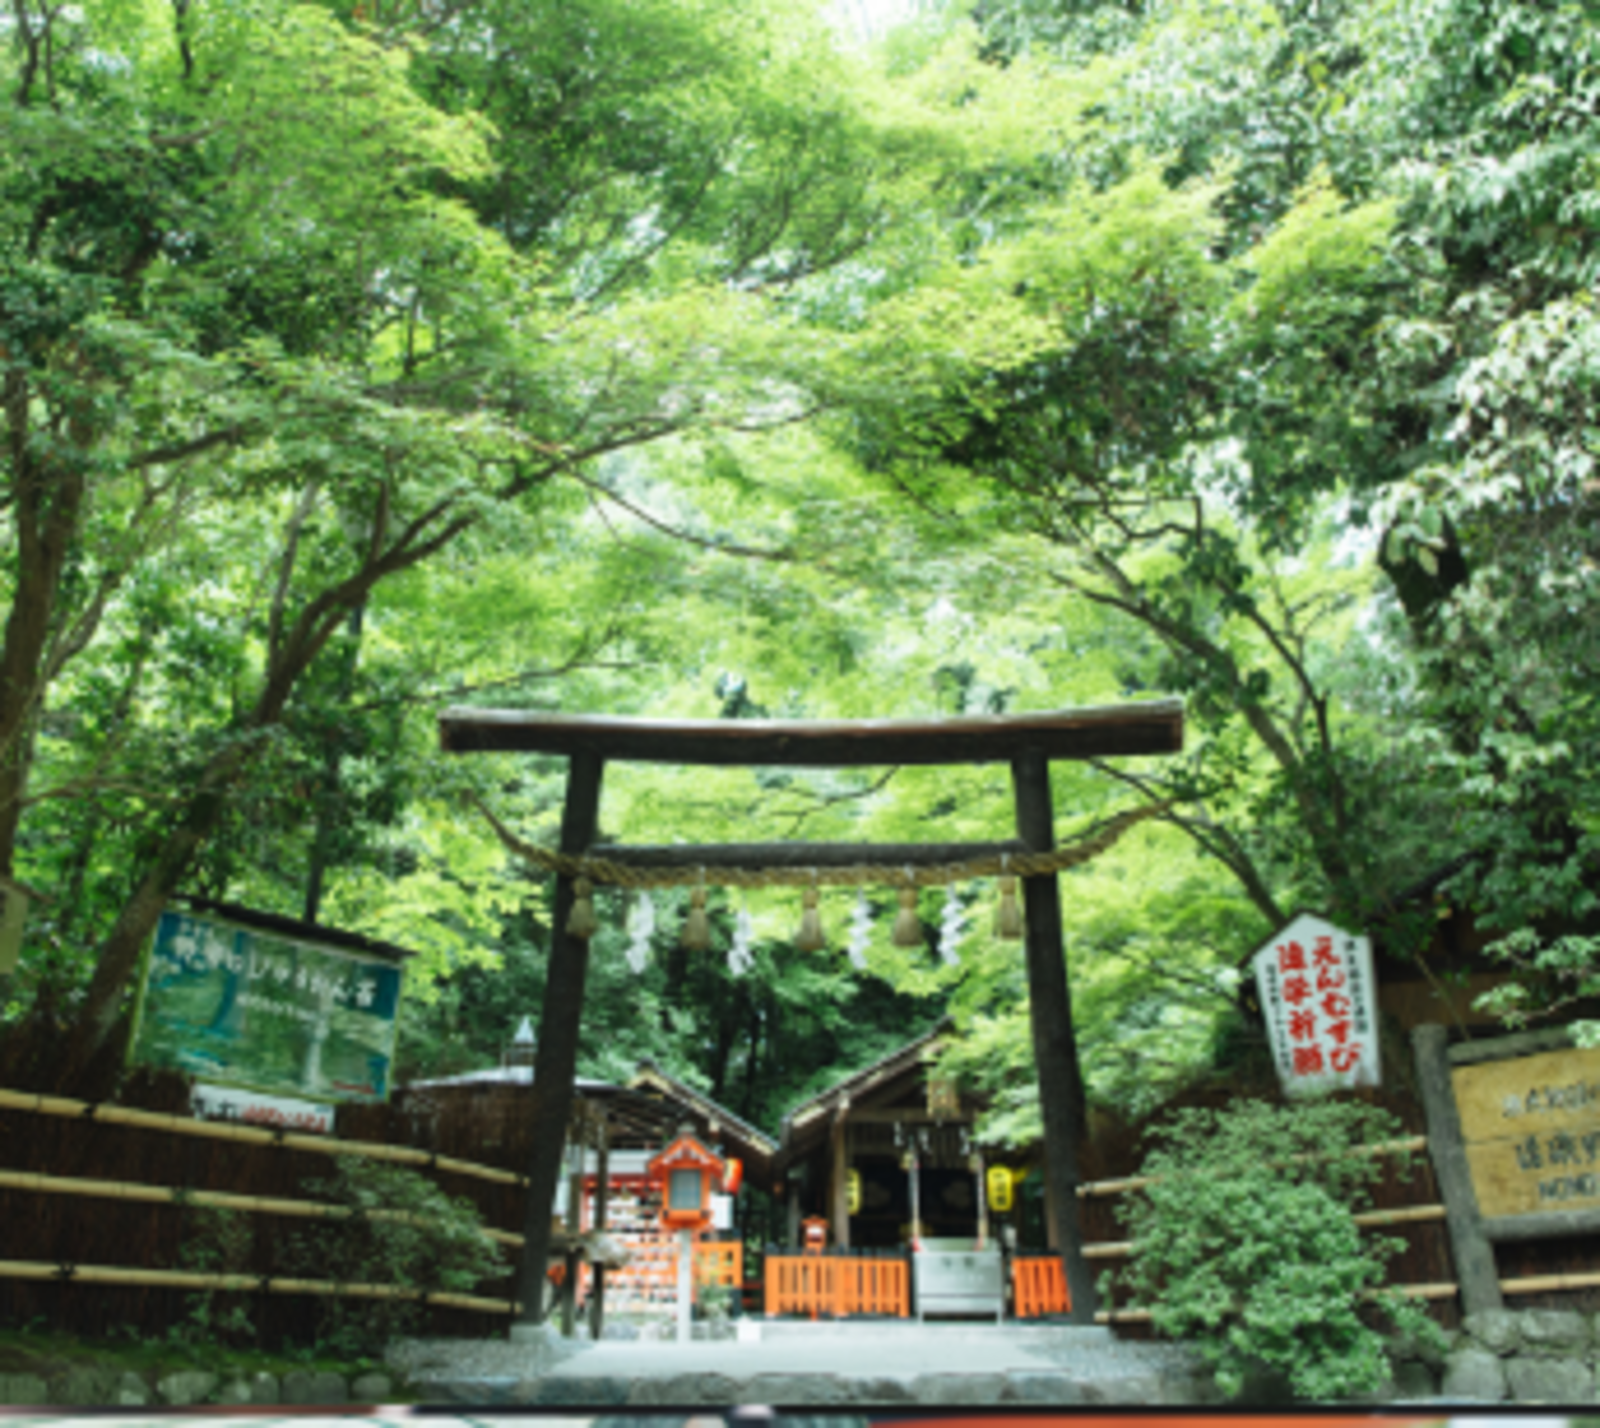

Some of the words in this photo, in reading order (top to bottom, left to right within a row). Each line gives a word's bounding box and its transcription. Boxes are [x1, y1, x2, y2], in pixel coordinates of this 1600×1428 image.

[1311, 936, 1363, 1073] えんむすび
